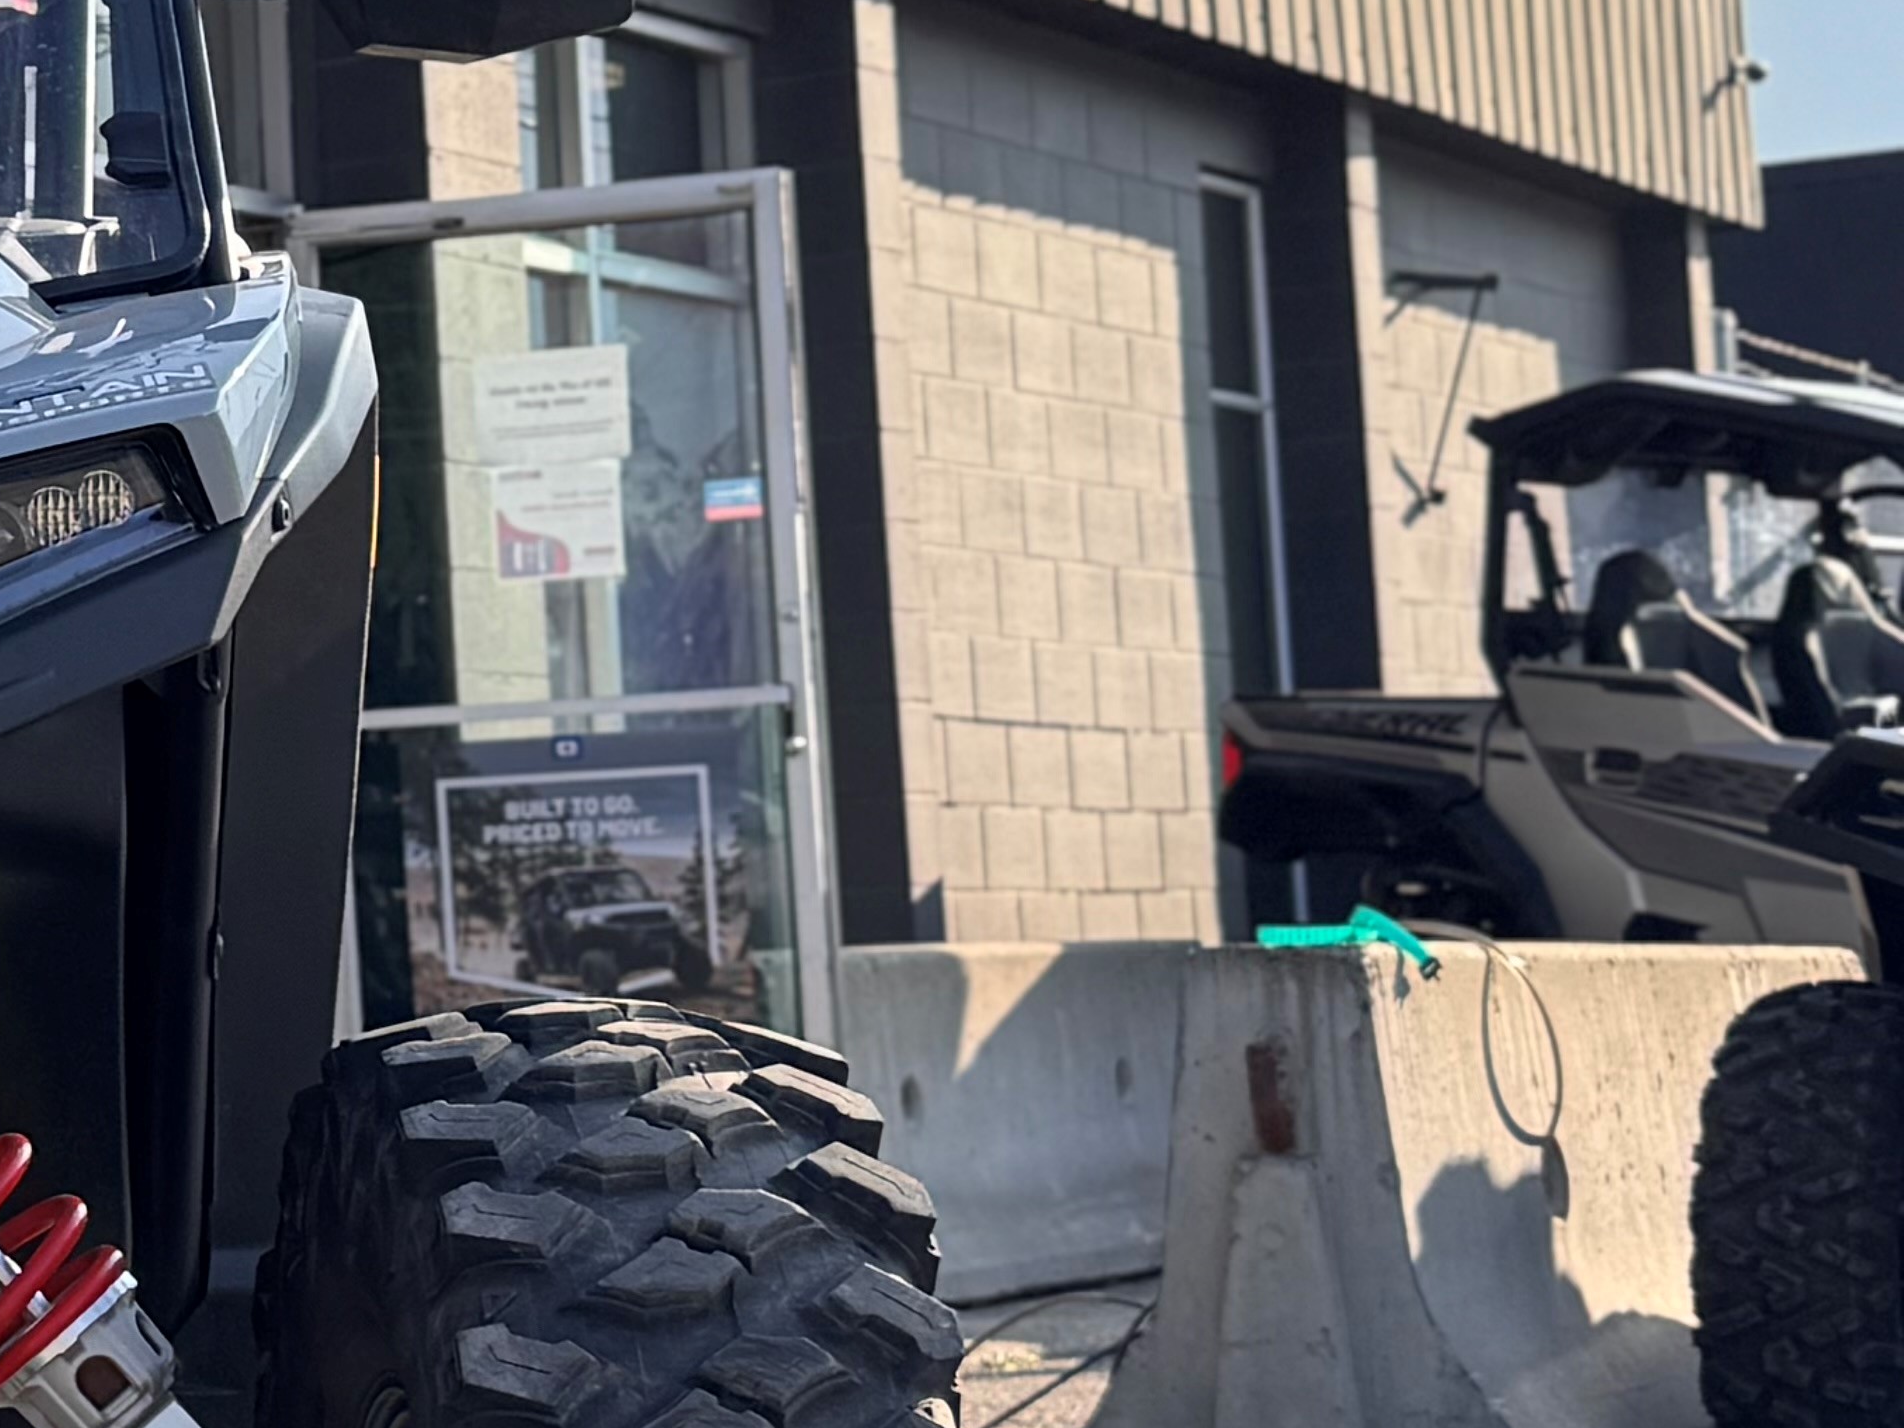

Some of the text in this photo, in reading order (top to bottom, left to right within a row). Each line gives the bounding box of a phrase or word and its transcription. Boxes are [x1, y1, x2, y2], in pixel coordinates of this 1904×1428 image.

[504, 797, 565, 820] BUILT
[571, 795, 599, 816] TO
[565, 820, 594, 841] TO
